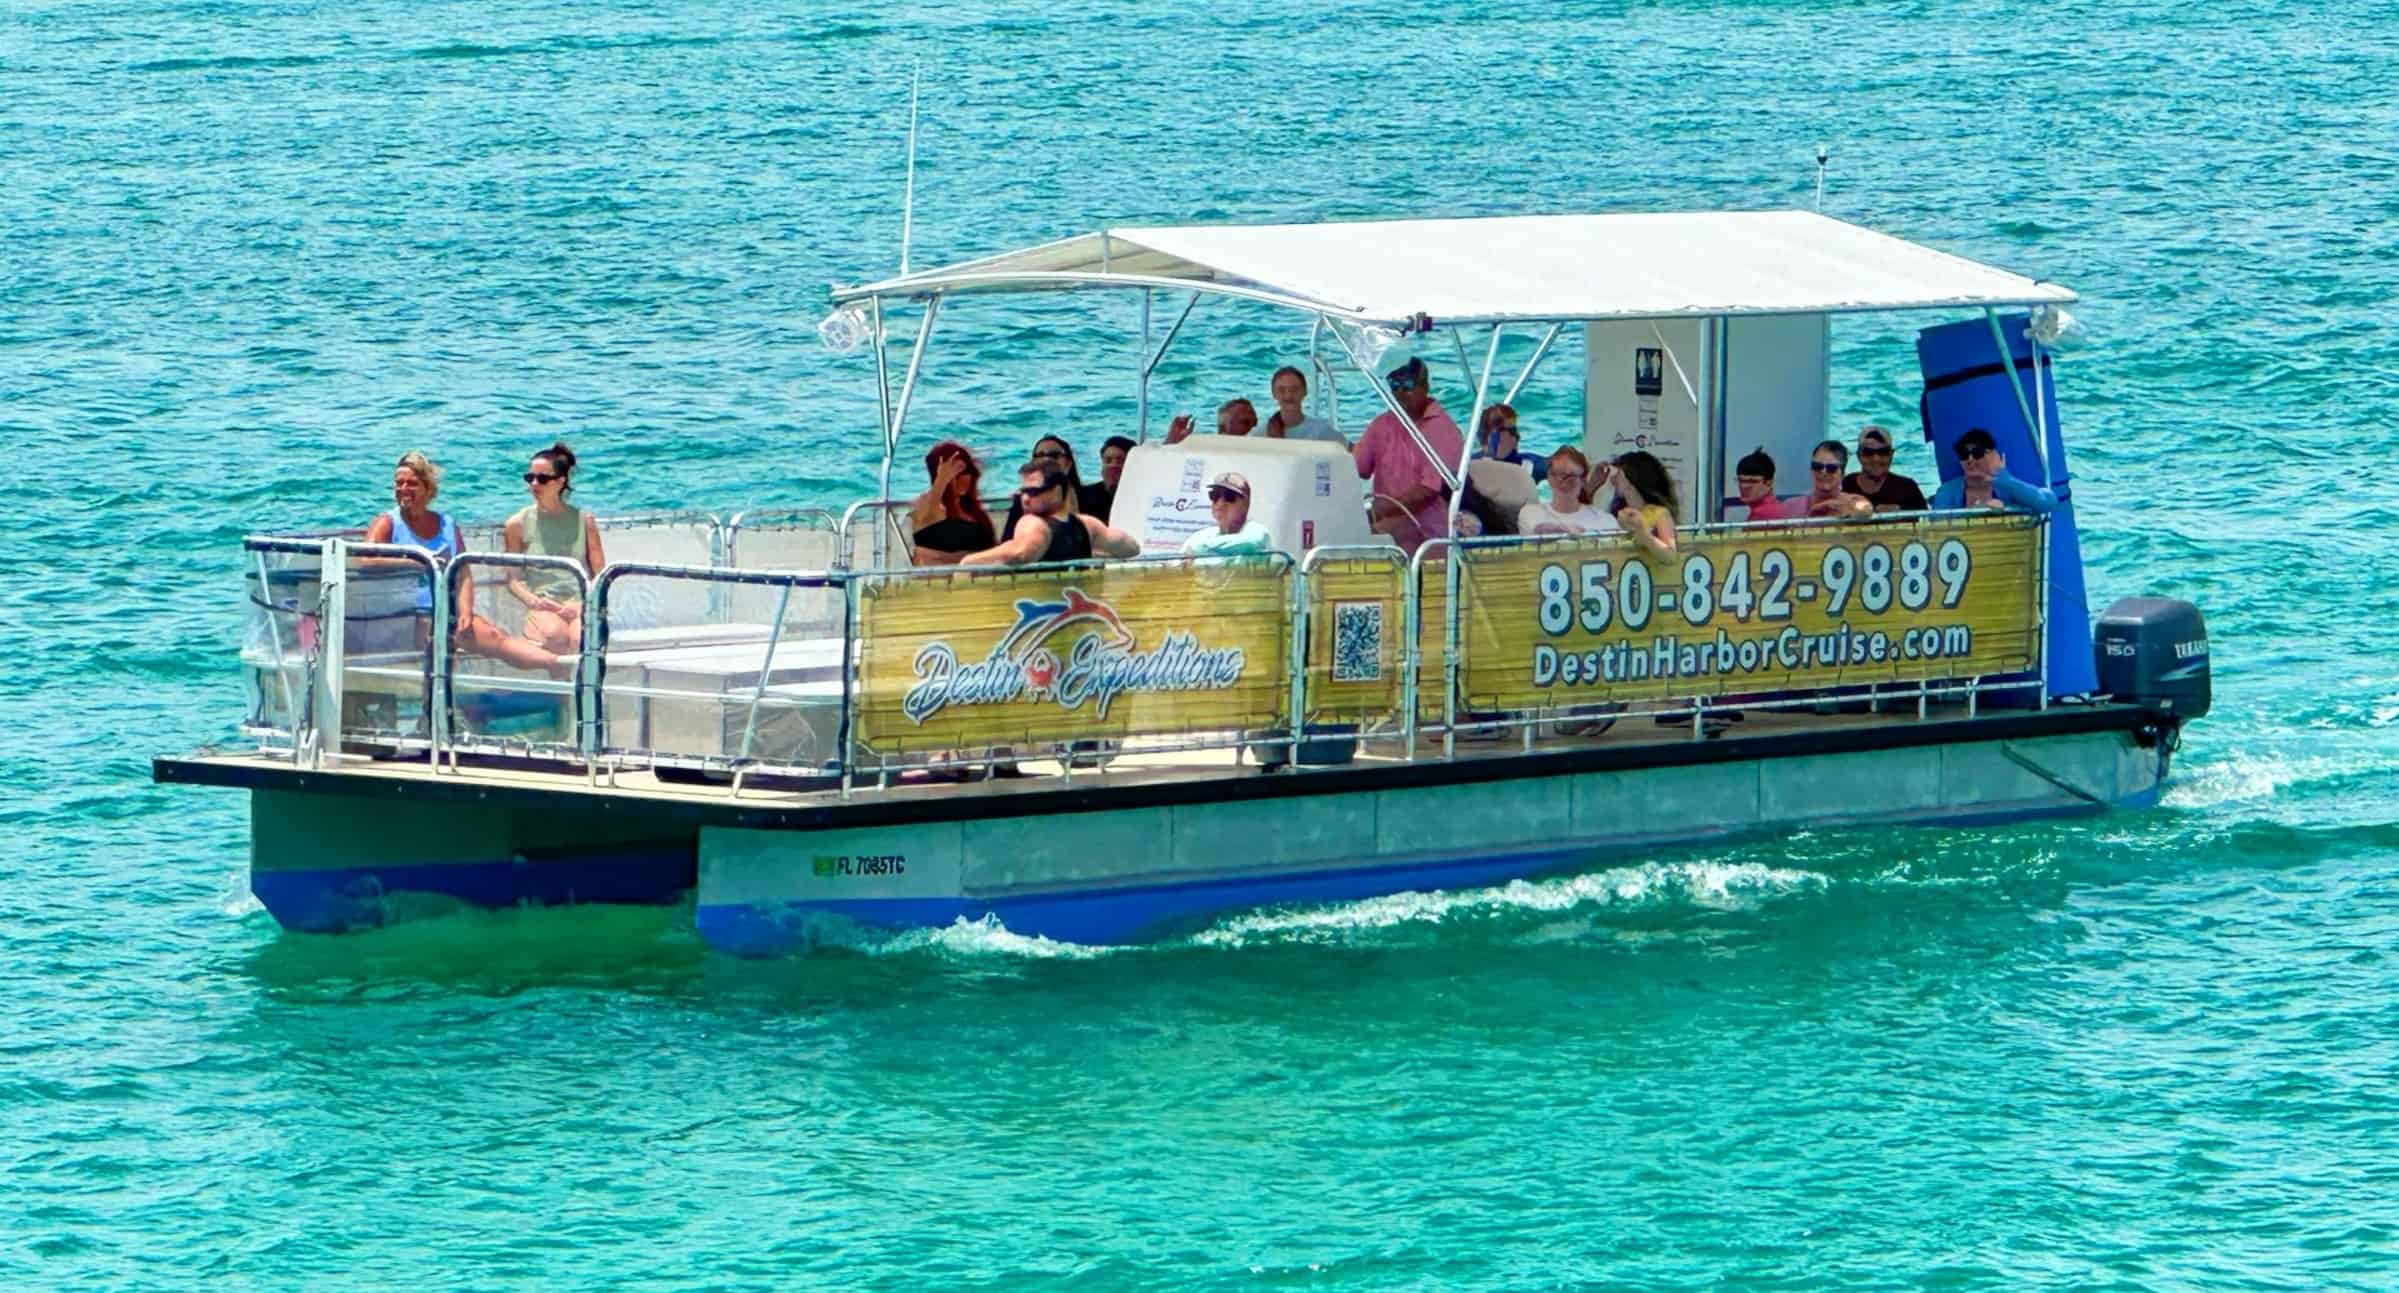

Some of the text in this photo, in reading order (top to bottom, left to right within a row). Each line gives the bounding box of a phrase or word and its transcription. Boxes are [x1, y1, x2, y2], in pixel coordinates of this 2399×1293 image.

[1538, 538, 1972, 636] 850-842-9889
[903, 629, 1247, 726] Destin Expeditions
[1533, 621, 1971, 687] DestinHarborCruise.com
[2106, 643, 2137, 657] 150
[837, 856, 853, 875] FL
